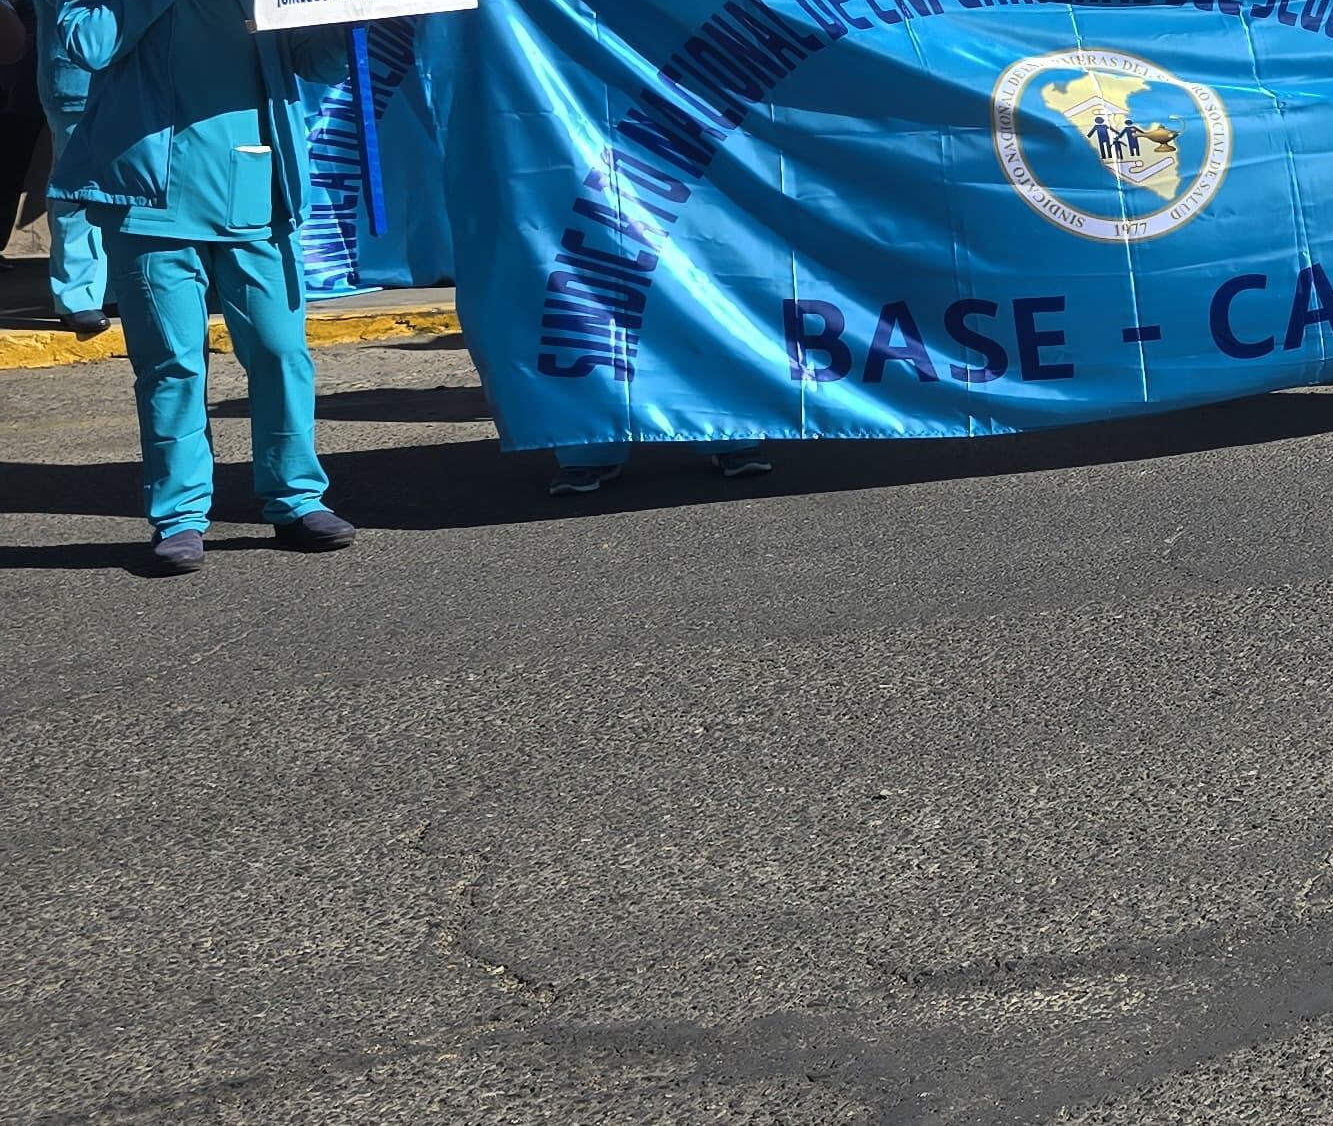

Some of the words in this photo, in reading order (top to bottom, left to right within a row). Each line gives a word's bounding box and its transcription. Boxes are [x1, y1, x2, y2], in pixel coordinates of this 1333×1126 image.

[998, 88, 1021, 162] NACIONAL
[1205, 103, 1225, 154] SOCIAL
[1012, 166, 1086, 228] SINDICATO
[1208, 162, 1221, 180] DE
[1170, 180, 1210, 220] SALUD
[1114, 223, 1147, 236] 1977
[538, 147, 692, 383] SINDICATO
[783, 296, 1074, 384] BASE
[1122, 324, 1162, 342] -
